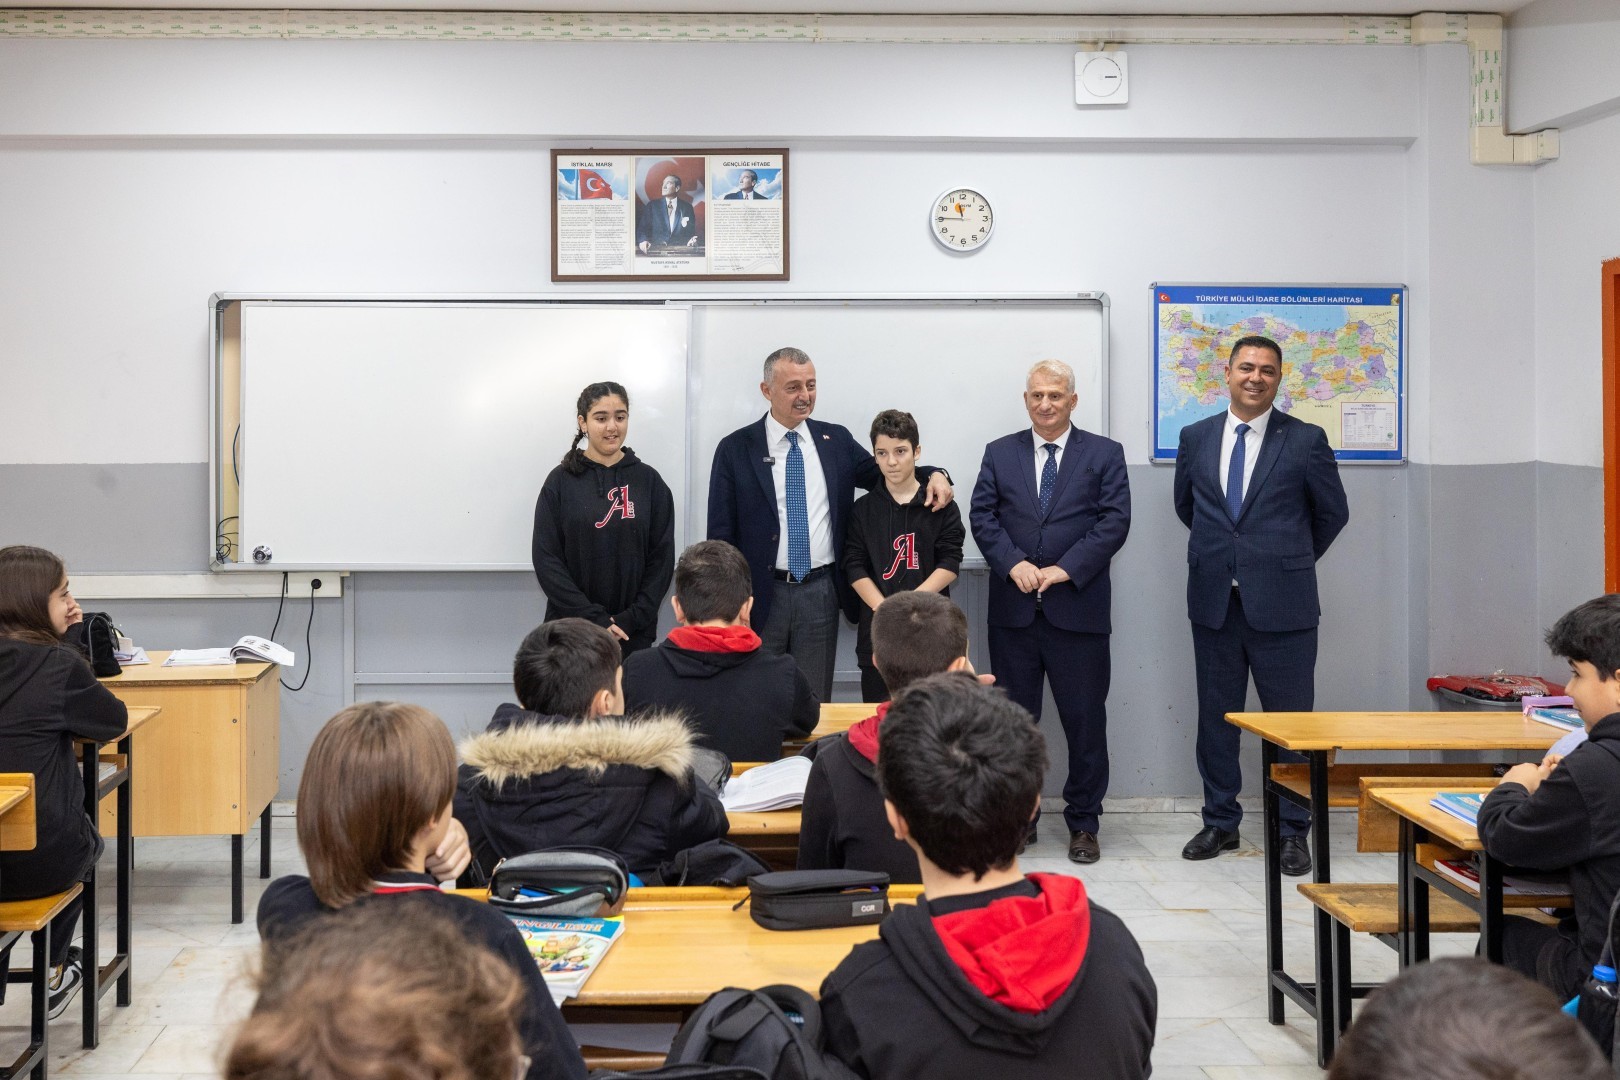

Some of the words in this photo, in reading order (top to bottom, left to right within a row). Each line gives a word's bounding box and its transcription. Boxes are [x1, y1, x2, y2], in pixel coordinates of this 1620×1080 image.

[1195, 294, 1229, 302] TÜRKİYE
[1230, 294, 1254, 303] MÜLKİ
[1255, 295, 1279, 303] İDARE
[1280, 295, 1326, 303] BÖLÜMLERİ
[1327, 295, 1363, 304] HARİTASI
